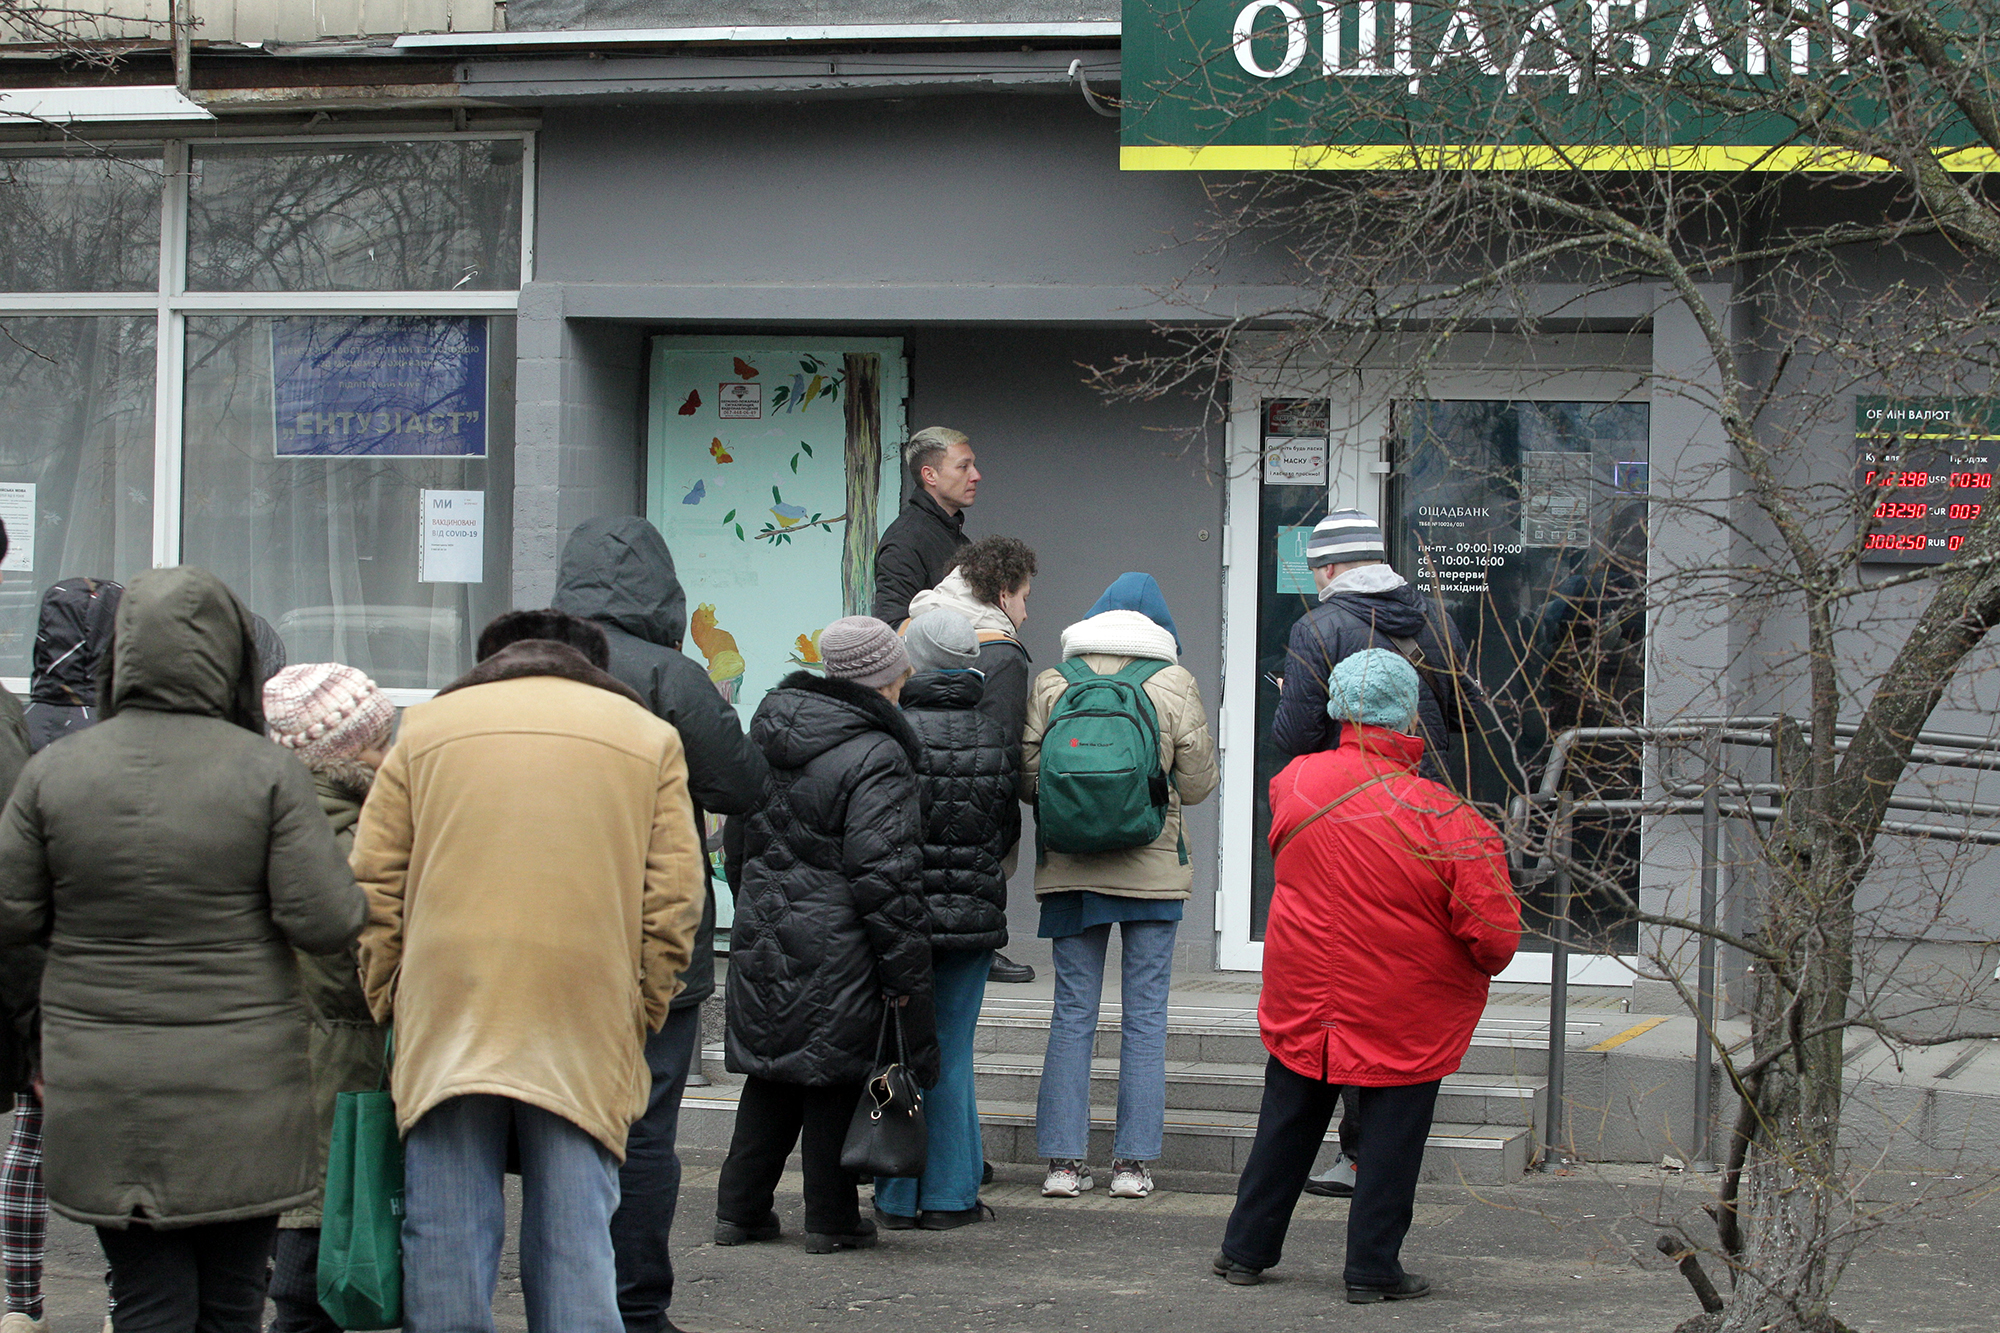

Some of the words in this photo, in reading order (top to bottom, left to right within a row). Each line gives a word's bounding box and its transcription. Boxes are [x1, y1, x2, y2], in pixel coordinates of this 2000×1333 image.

[1232, 0, 1883, 94] ОЩАДБАНК
[1908, 410, 1951, 420] ВАЛЮТ
[1928, 475, 1947, 484] USD
[432, 499, 452, 509] МИ
[1418, 506, 1490, 518] ОЩАДБАНК
[445, 530, 478, 538] COVID-19
[1456, 542, 1522, 554] 09:00-19:00
[1928, 538, 1946, 547] RUB
[1417, 555, 1430, 565] сб
[1441, 555, 1505, 566] 10:00-16:00
[1417, 568, 1436, 578] без
[1439, 571, 1485, 581] перерви
[1417, 583, 1431, 592] нд
[1440, 581, 1489, 593] вихідний
